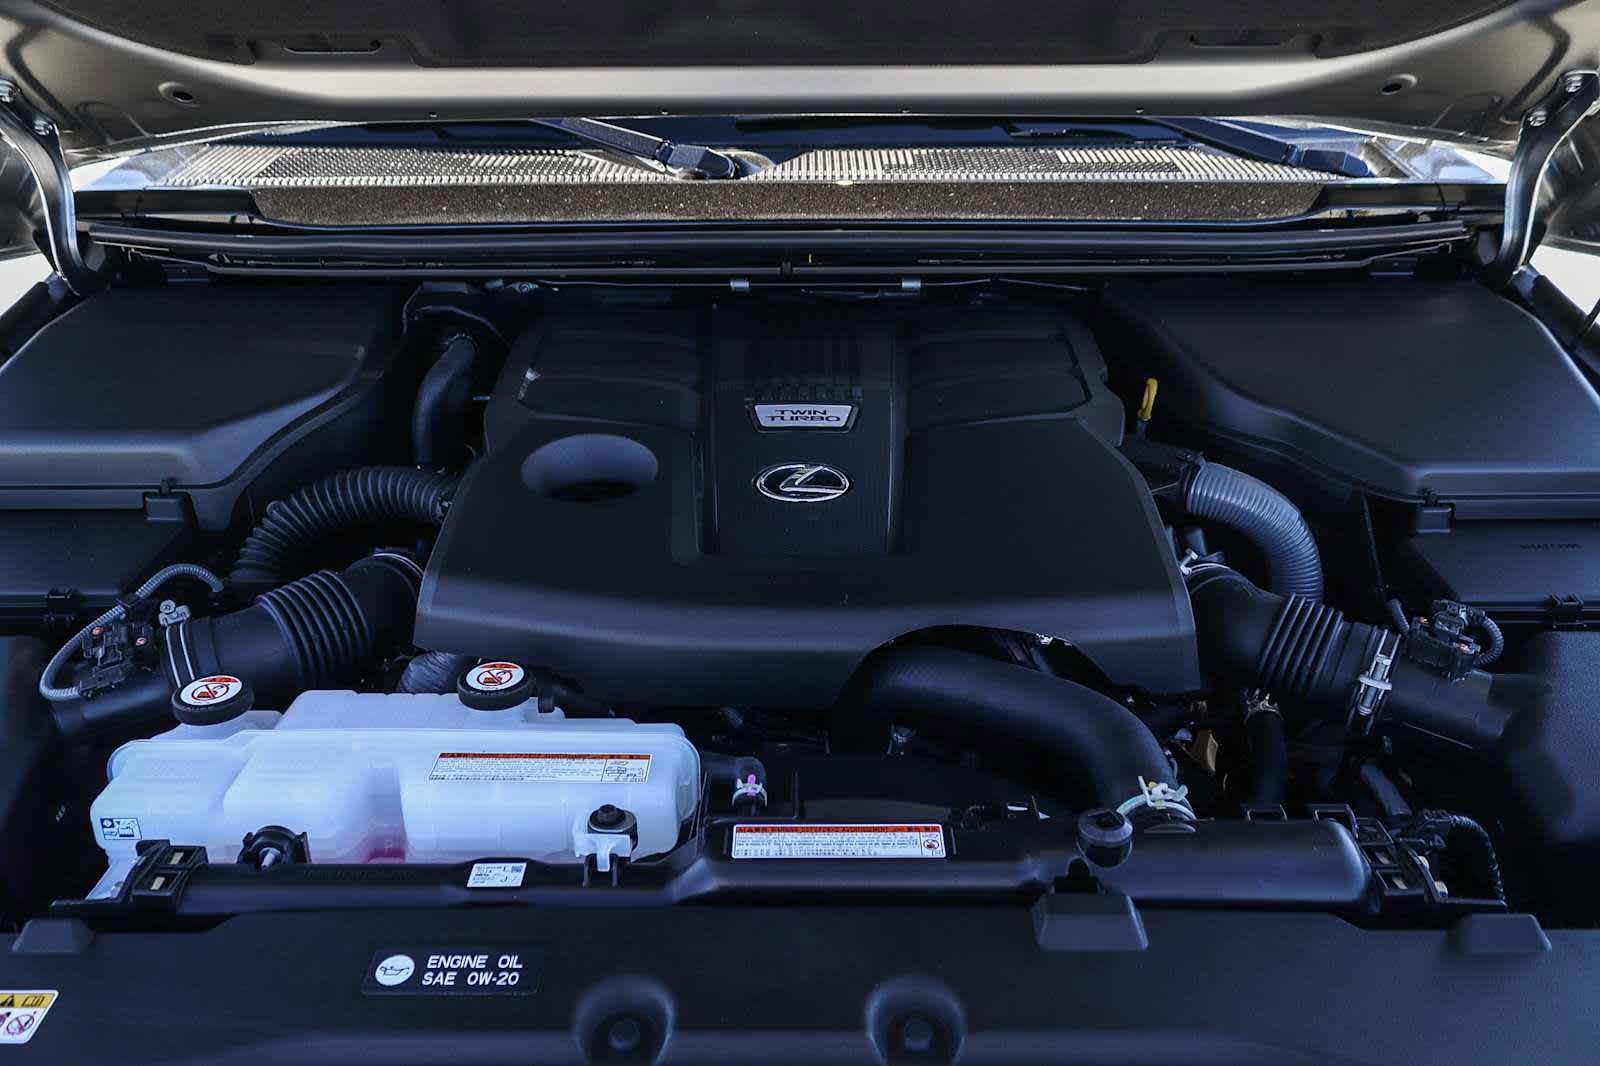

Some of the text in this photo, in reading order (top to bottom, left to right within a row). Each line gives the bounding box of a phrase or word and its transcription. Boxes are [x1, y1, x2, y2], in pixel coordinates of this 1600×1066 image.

[426, 955, 523, 969] ENGINE OIL
[421, 971, 520, 986] SAE 0W-20
